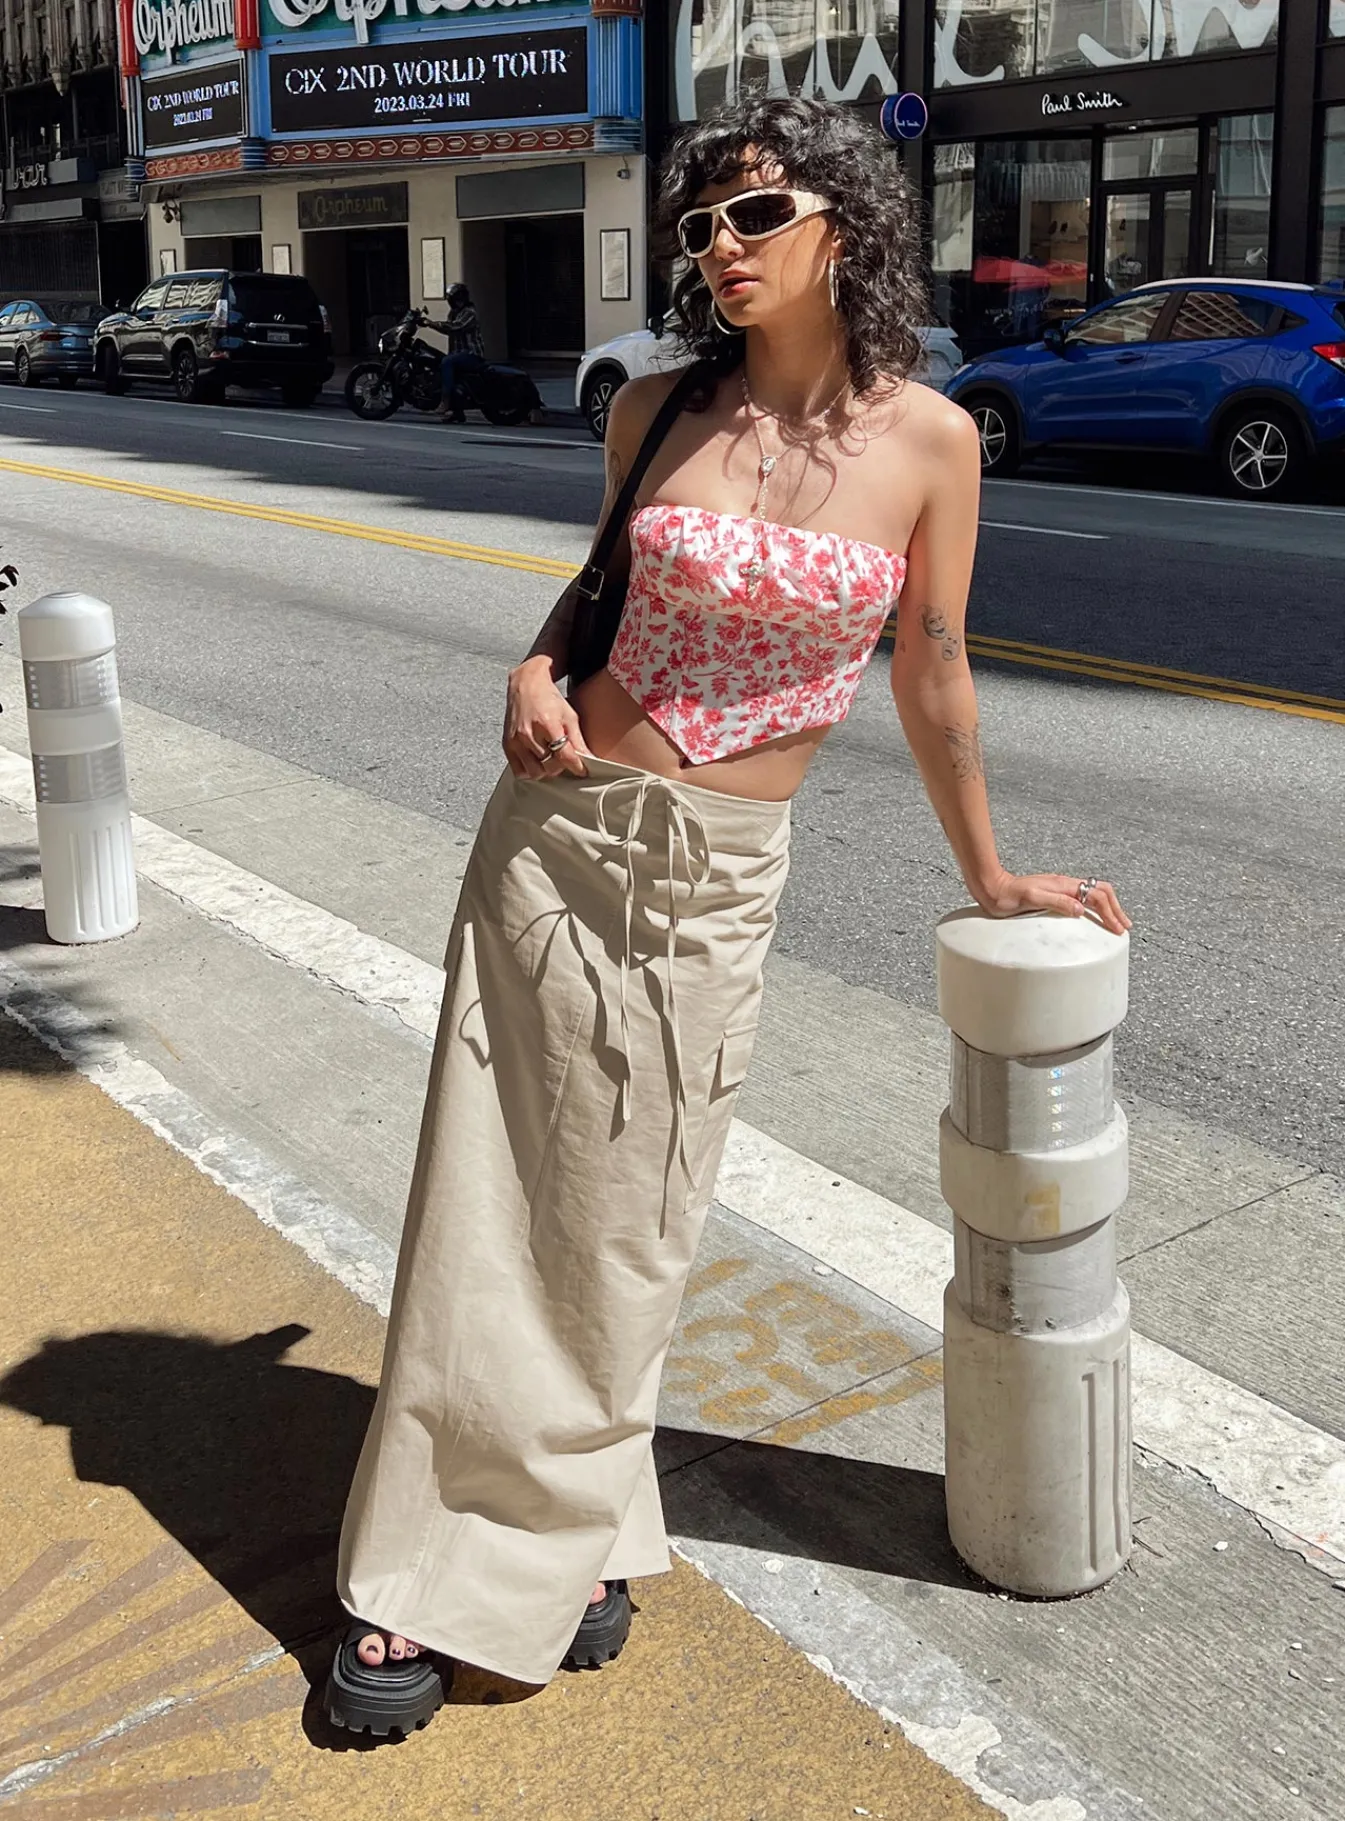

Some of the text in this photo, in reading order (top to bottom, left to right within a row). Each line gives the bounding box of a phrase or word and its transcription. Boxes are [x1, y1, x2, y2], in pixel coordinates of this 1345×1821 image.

[285, 49, 568, 94] CIX 2ND WORLD TOUR
[373, 91, 470, 114] 2023.03.24 FRI
[1041, 91, 1123, 115] Paul Smith
